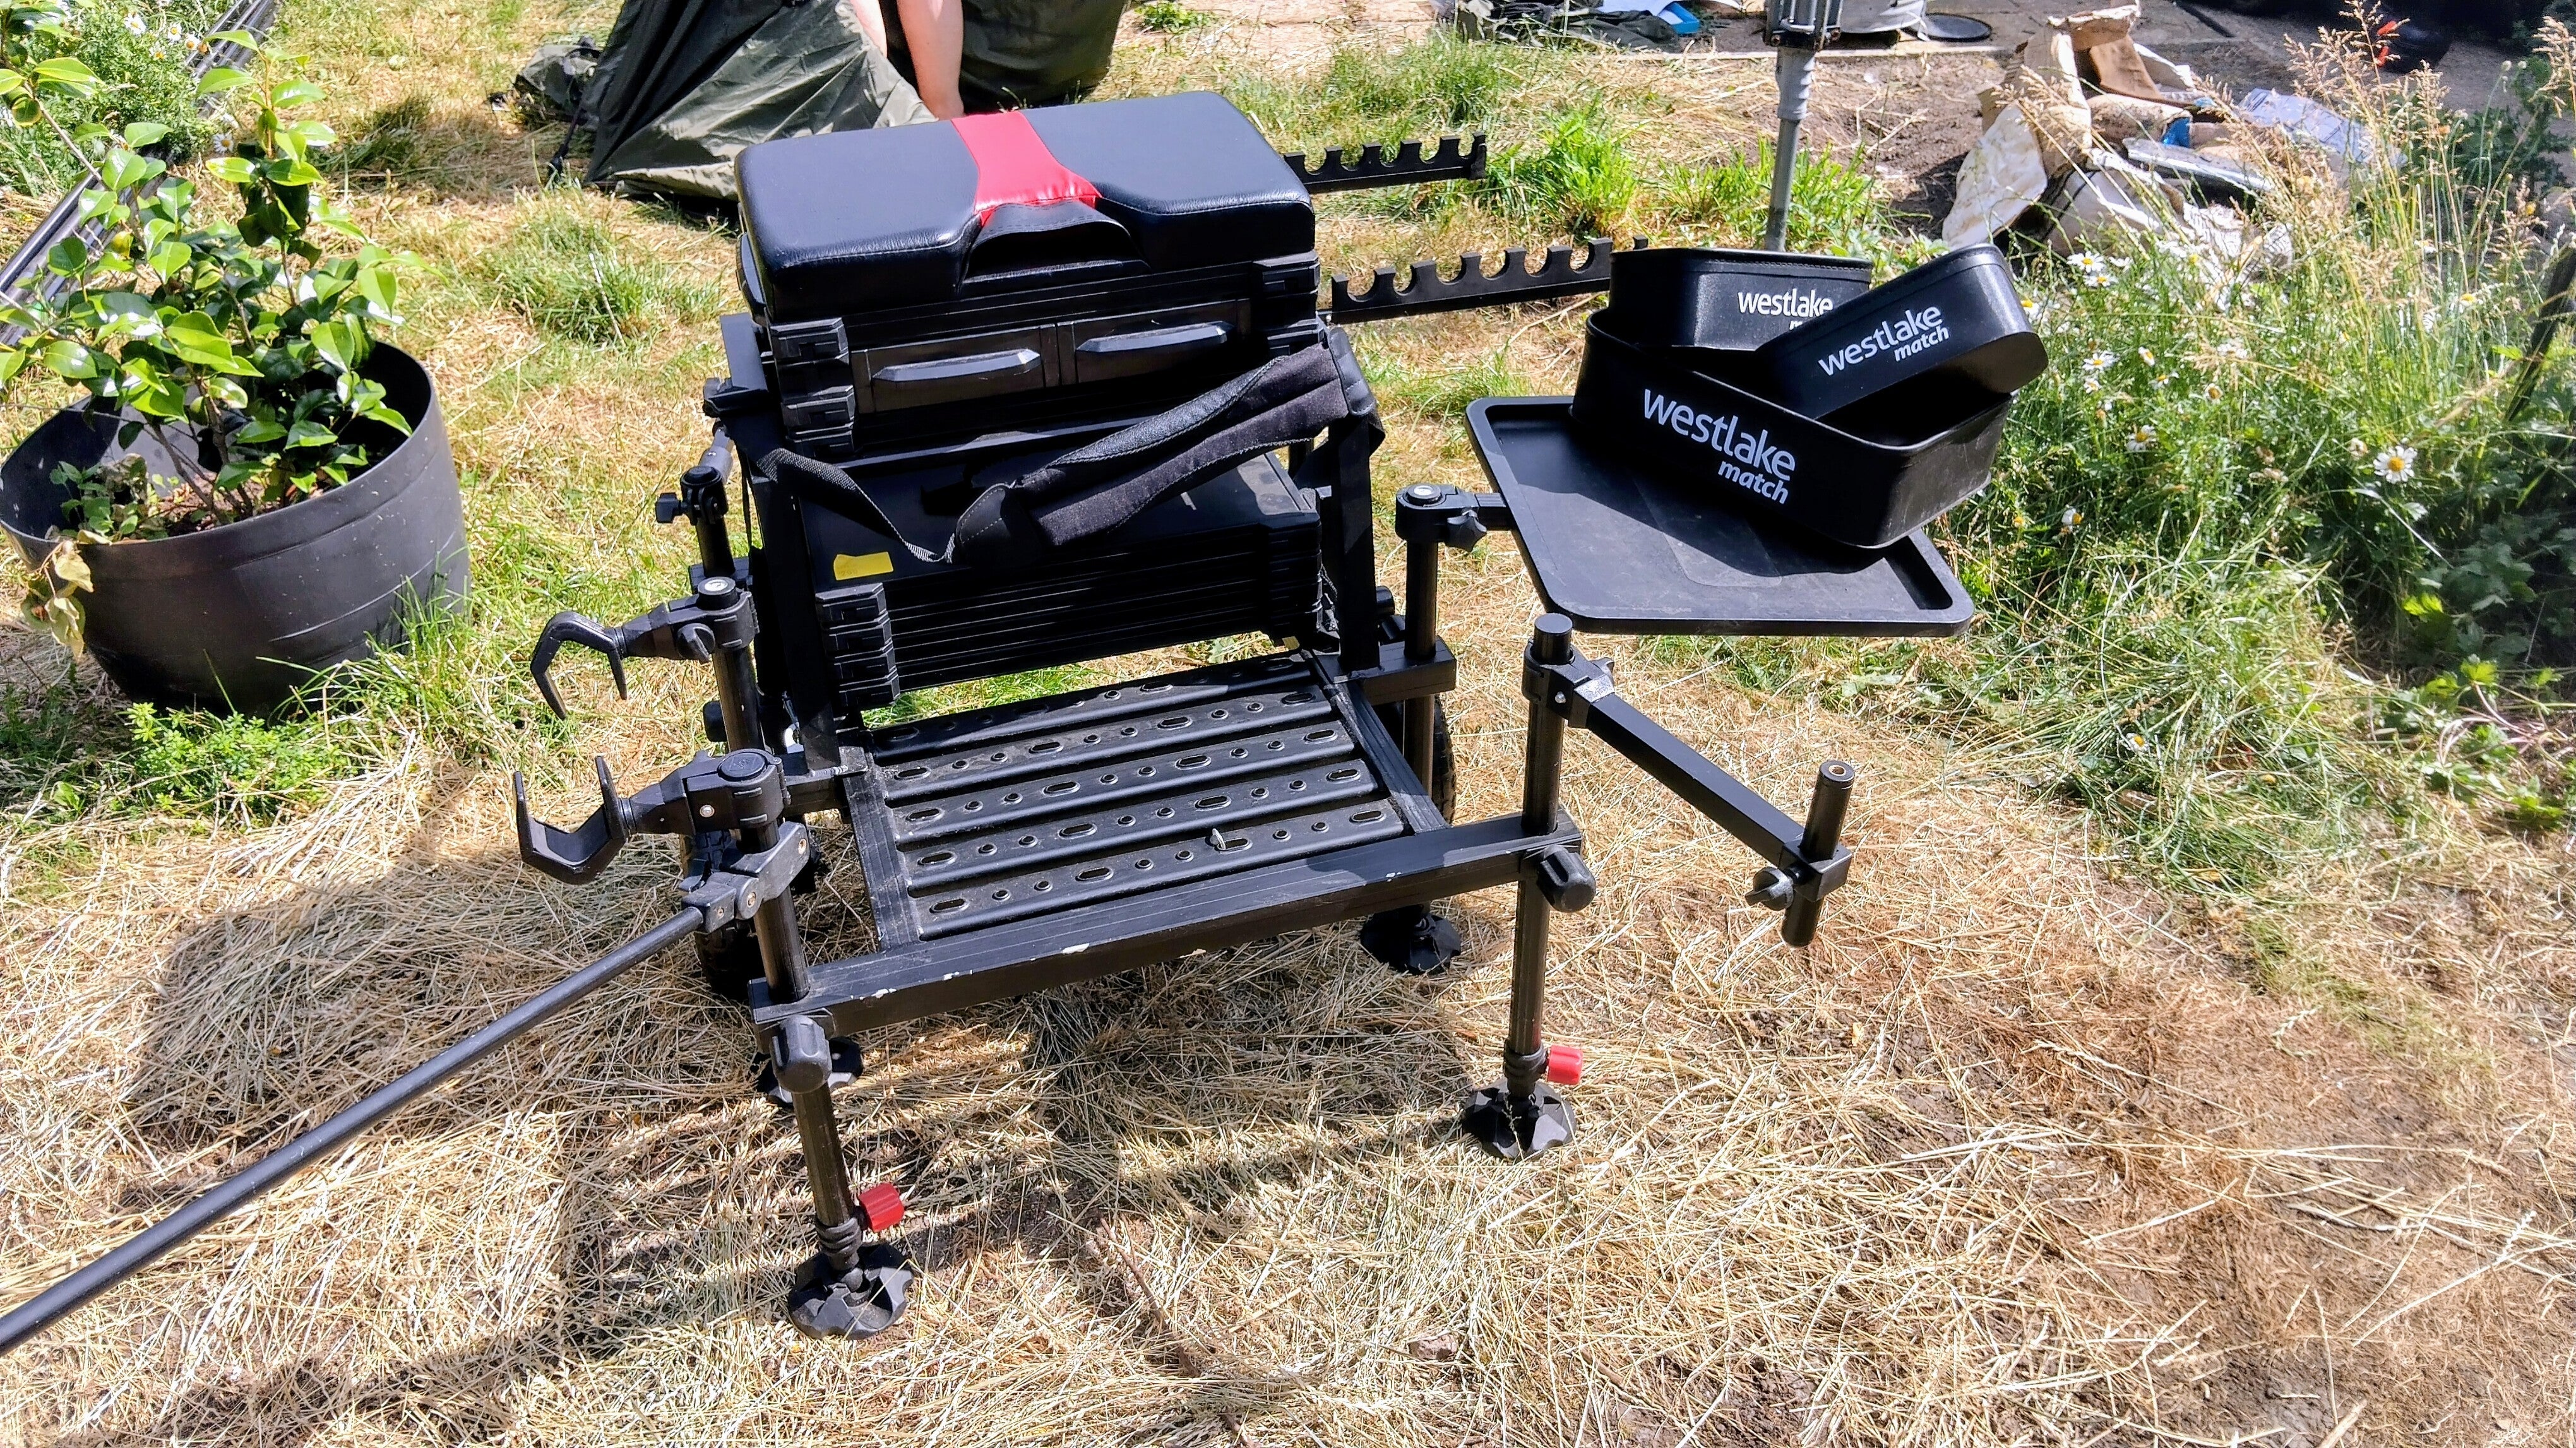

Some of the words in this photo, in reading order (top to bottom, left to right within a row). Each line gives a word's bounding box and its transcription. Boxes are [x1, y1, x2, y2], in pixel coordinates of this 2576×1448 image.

[1738, 288, 1834, 317] westlake
[1818, 306, 1943, 376] westlake
[1894, 325, 1949, 362] match
[1644, 388, 1796, 481] westlake
[1717, 460, 1789, 504] match
